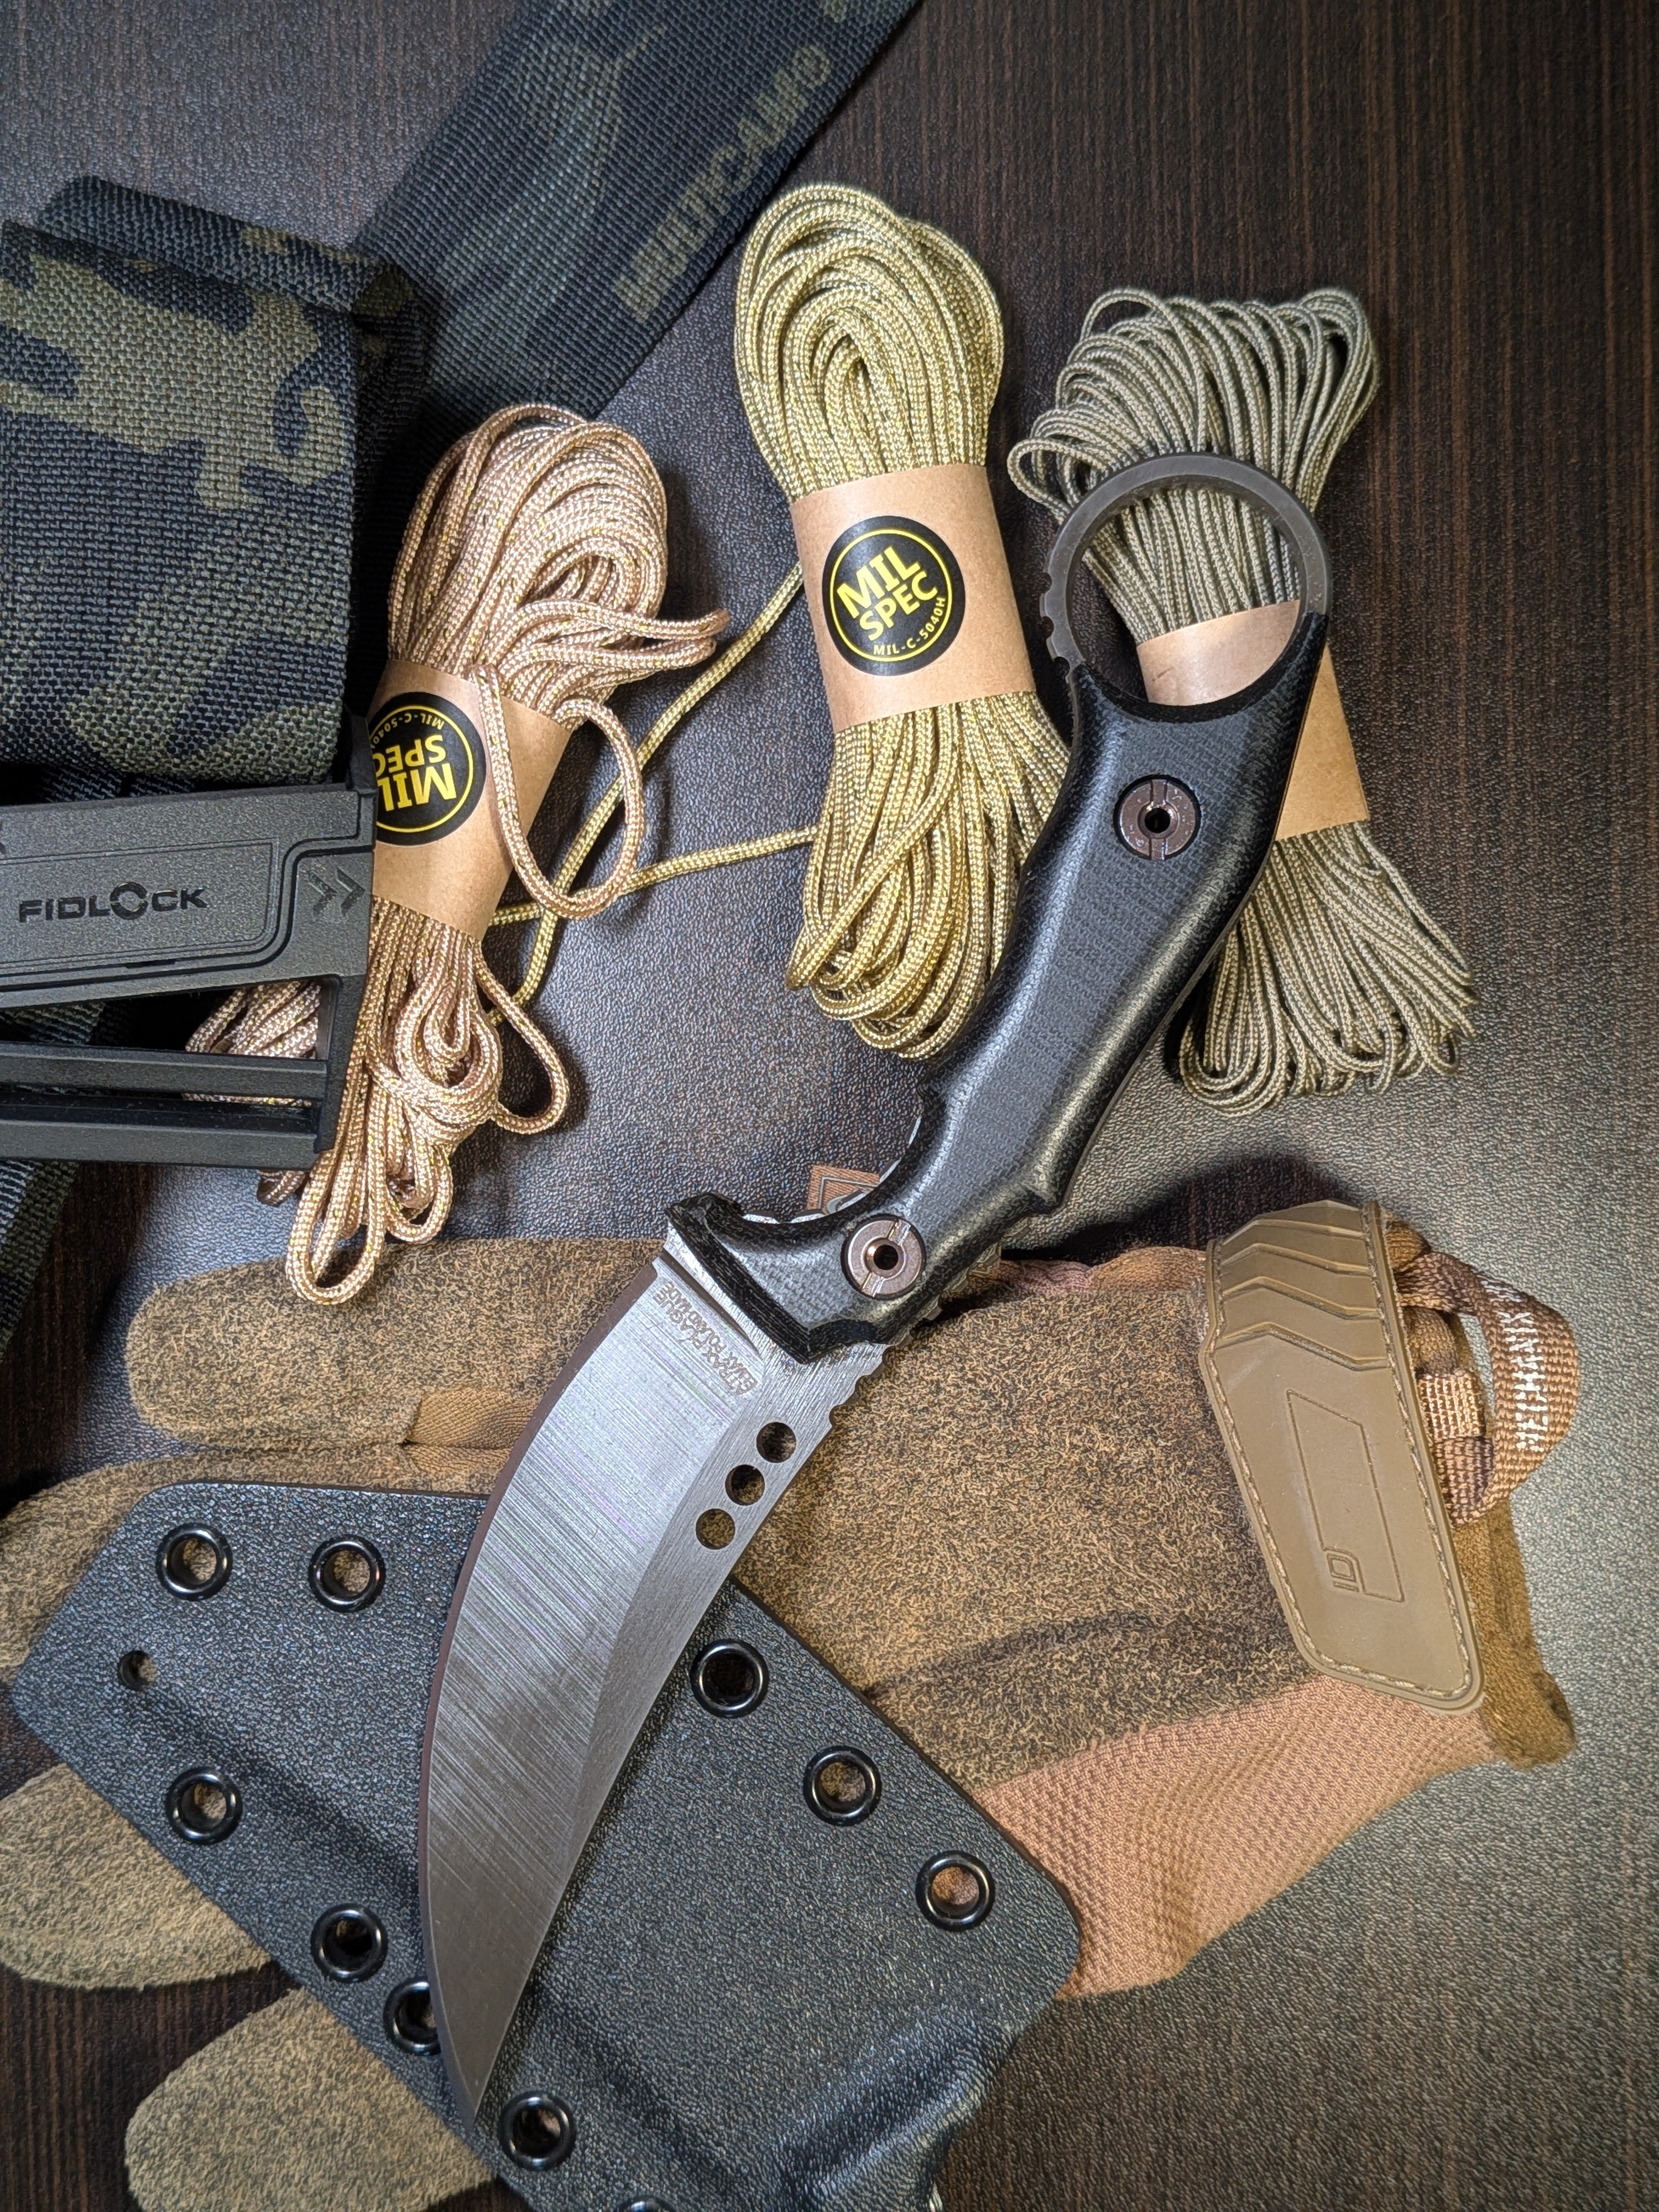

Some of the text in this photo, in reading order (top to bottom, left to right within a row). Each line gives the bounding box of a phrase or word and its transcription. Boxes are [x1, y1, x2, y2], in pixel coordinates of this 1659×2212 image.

[836, 546, 920, 619] MIL
[859, 571, 938, 641] SPEC
[873, 596, 946, 656] MIL-C-5040H
[371, 713, 445, 749] MIL-C-5040
[372, 734, 446, 778] SPEC
[377, 763, 457, 812] MIL
[18, 881, 208, 923] FIDLOCK
[653, 1290, 749, 1396] ATRAX PLAGUE
